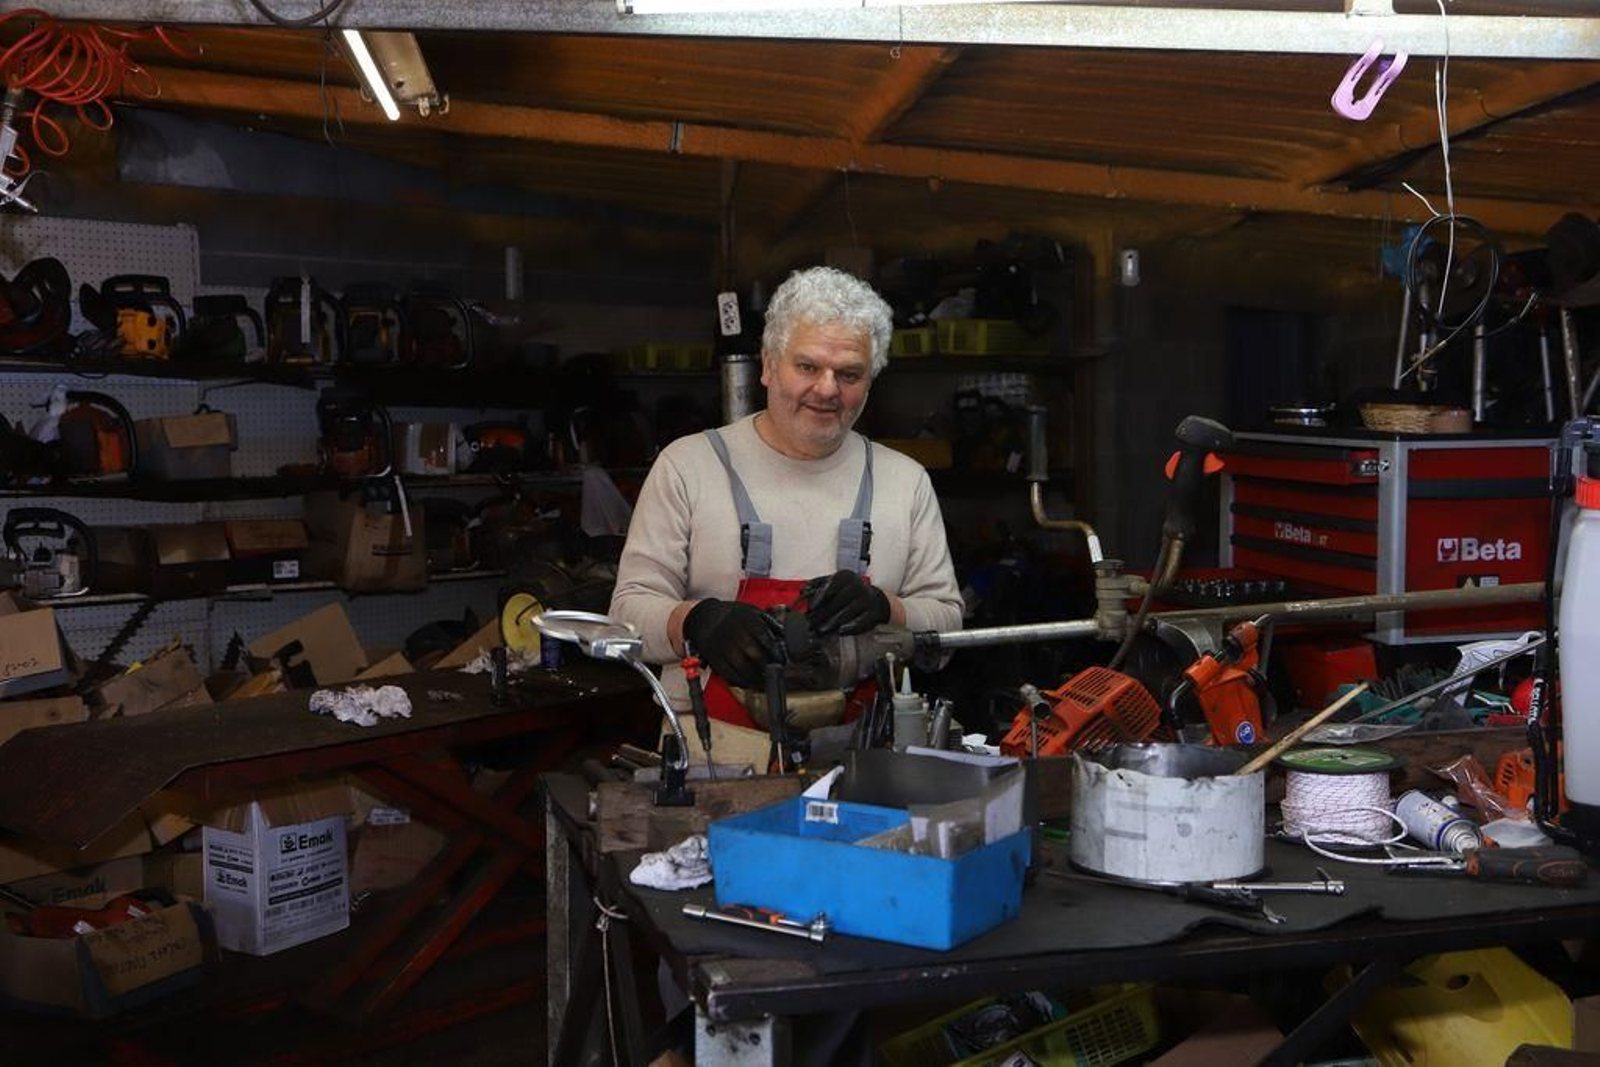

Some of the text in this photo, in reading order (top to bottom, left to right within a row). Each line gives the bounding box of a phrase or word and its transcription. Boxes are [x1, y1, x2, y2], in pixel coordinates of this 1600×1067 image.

[1460, 537, 1522, 562] Beta
[299, 827, 334, 850] Emak
[225, 873, 249, 888] Emak
